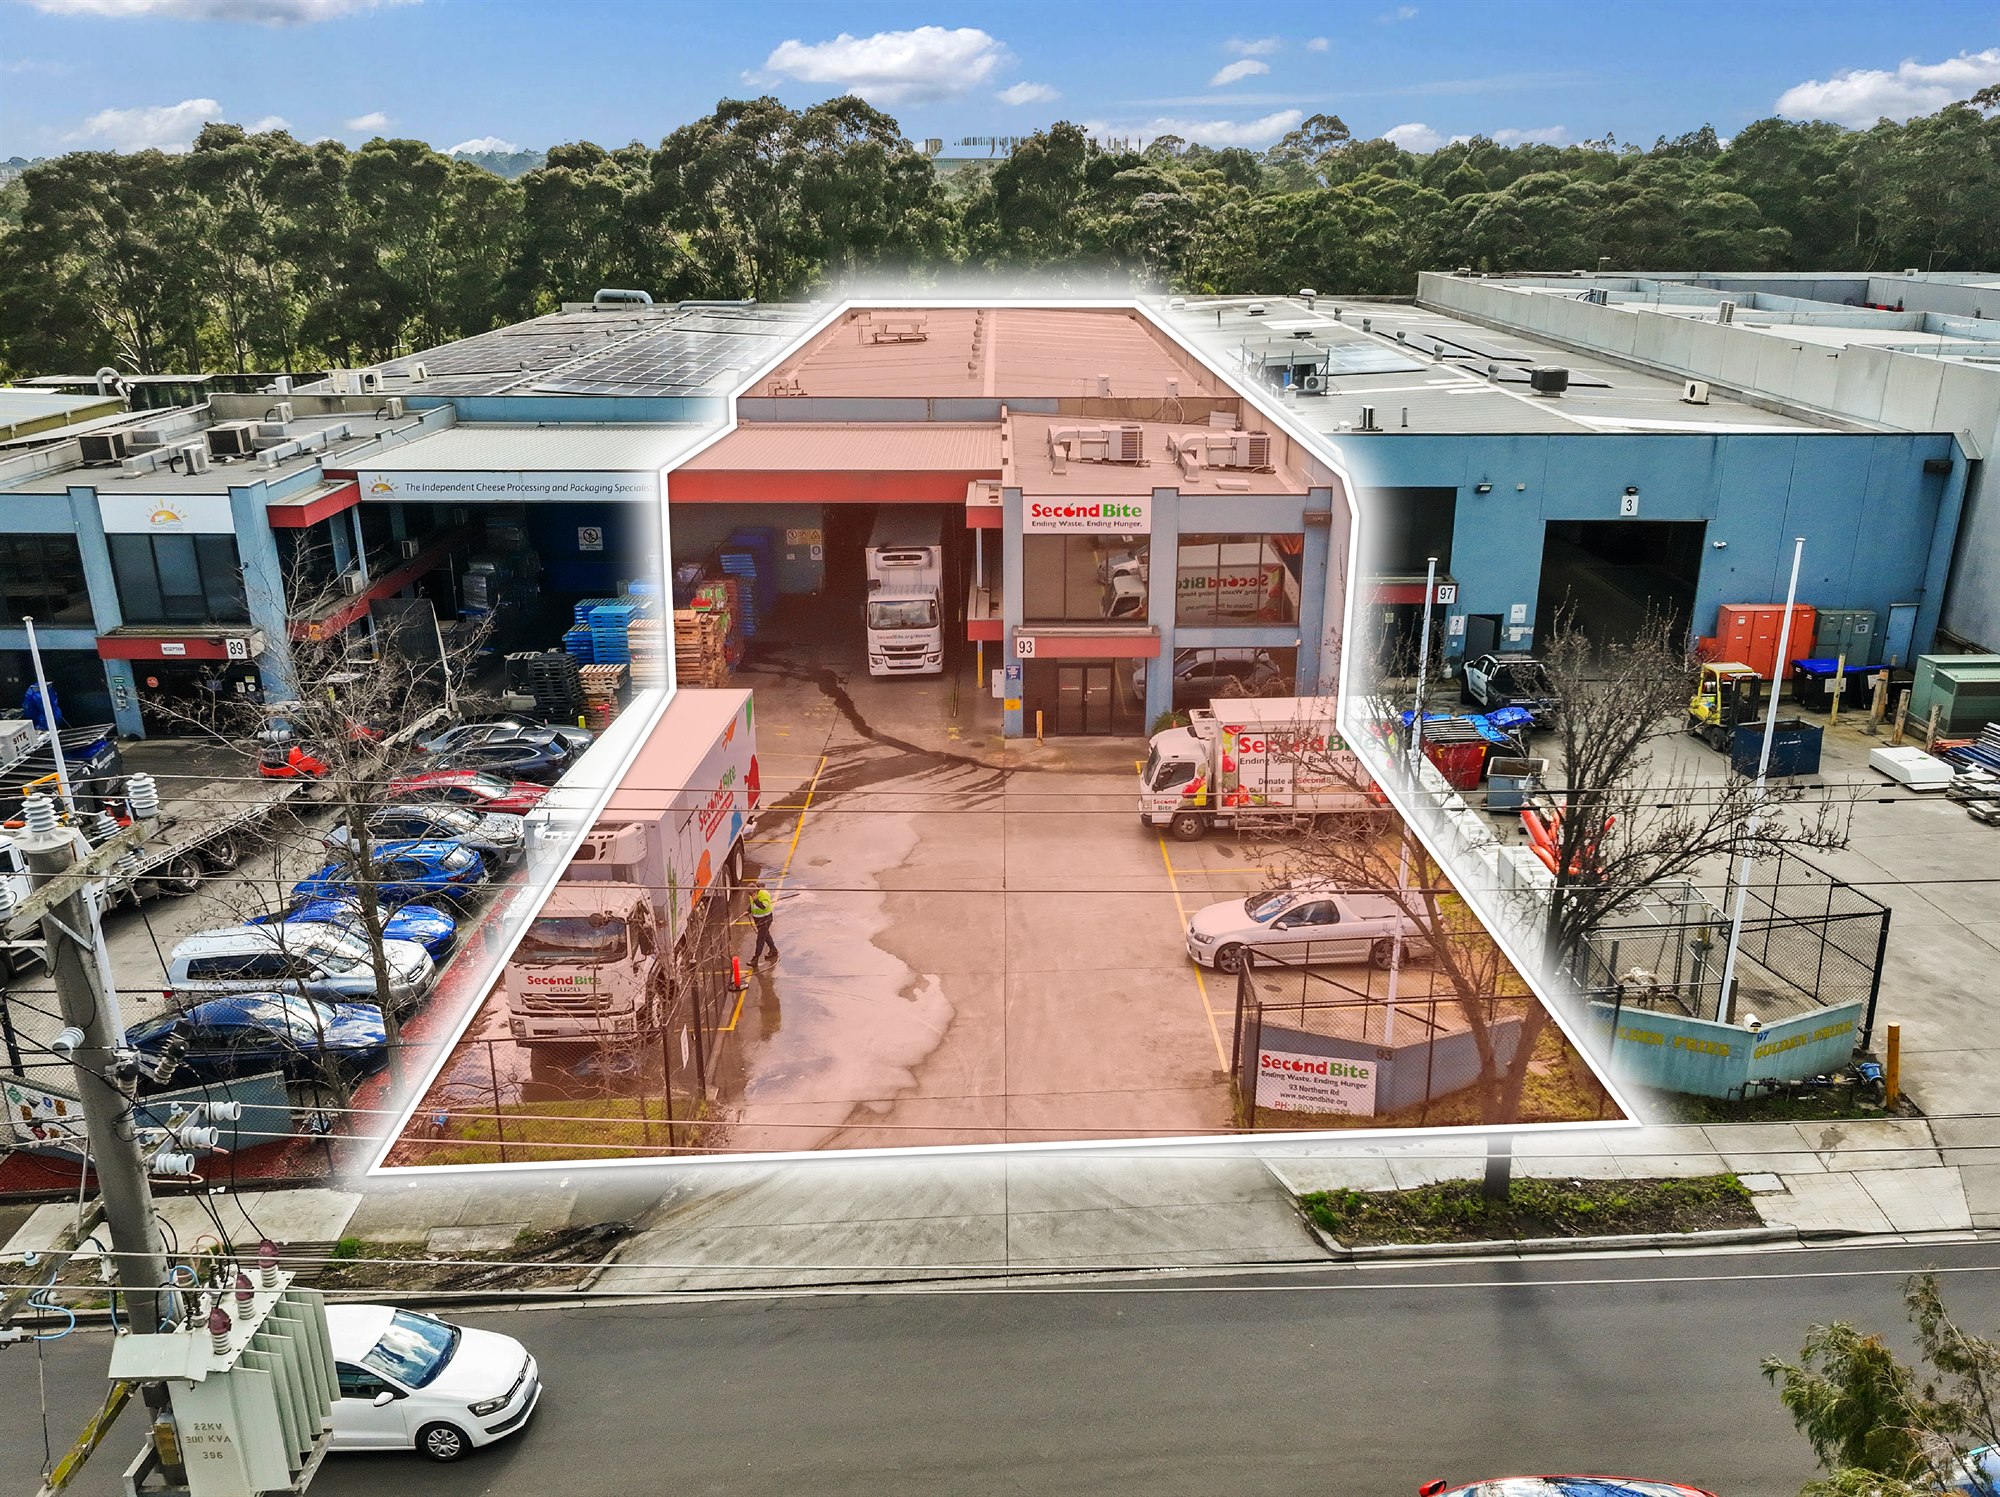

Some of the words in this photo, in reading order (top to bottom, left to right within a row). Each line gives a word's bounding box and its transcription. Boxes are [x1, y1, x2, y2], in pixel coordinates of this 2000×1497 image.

[405, 483, 420, 492] The
[422, 483, 475, 493] Independent
[476, 483, 506, 492] Cheese
[507, 484, 550, 494] Processing
[552, 483, 568, 492] and
[570, 483, 613, 494] Packaging
[1625, 499, 1633, 512] 3
[1031, 520, 1057, 528] Ending
[1086, 520, 1112, 528] Ending
[1113, 520, 1142, 528] Hunger.
[1439, 587, 1453, 600] 97
[229, 641, 244, 655] 89
[1018, 640, 1033, 654] 93
[1239, 757, 1270, 766] Ending
[1756, 1031, 1770, 1043] 97
[1376, 1049, 1392, 1061] 93
[1261, 1070, 1285, 1081] Ending
[1286, 1073, 1312, 1083] Waste.
[1313, 1077, 1339, 1088] Ending
[1288, 1083, 1298, 1091] 93
[1299, 1085, 1329, 1096] Northern
[1274, 1100, 1290, 1110] PH:
[185, 1435, 204, 1444] 300
[208, 1434, 232, 1443] KVA
[202, 1451, 224, 1460] 396
